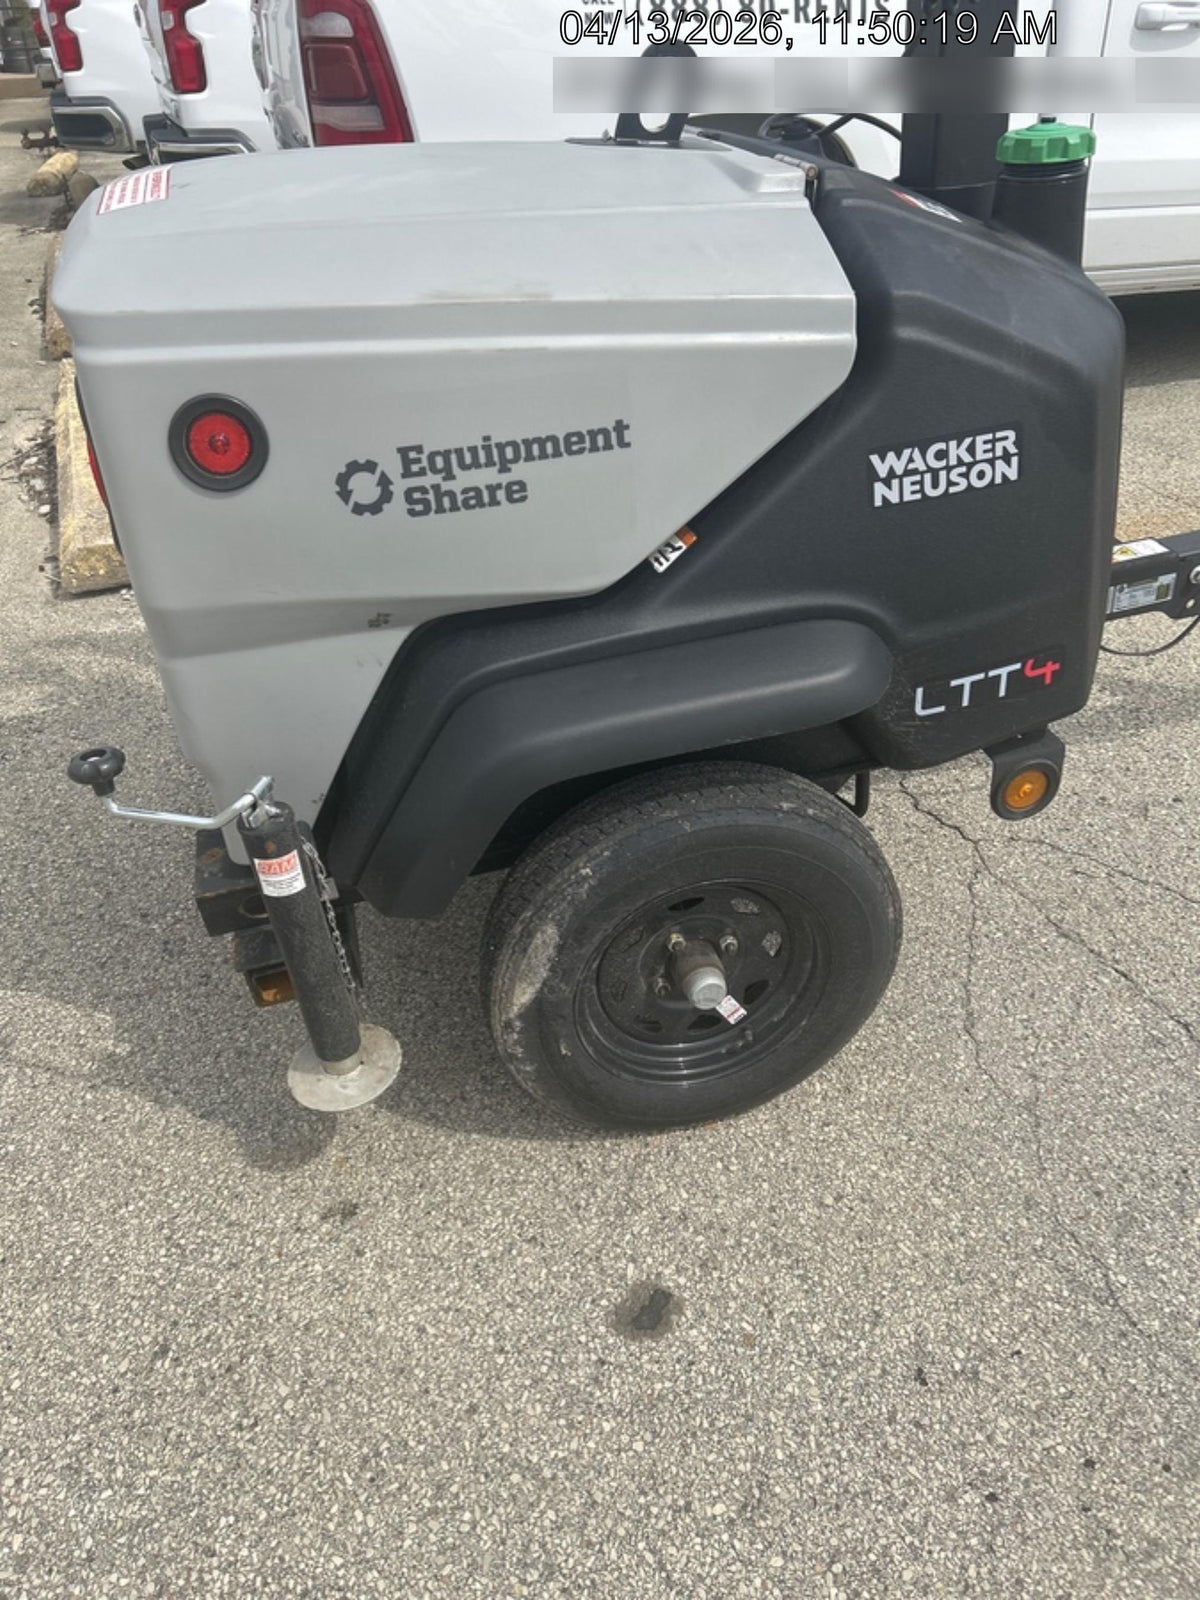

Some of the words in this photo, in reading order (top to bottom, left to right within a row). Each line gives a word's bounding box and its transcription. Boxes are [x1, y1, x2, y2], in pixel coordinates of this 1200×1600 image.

[584, 11, 614, 25] NW
[396, 419, 632, 482] Equipment
[868, 429, 1019, 479] WACKER
[403, 479, 529, 518] Share
[873, 455, 1019, 508] NEUSON
[914, 658, 1061, 717] LTT4
